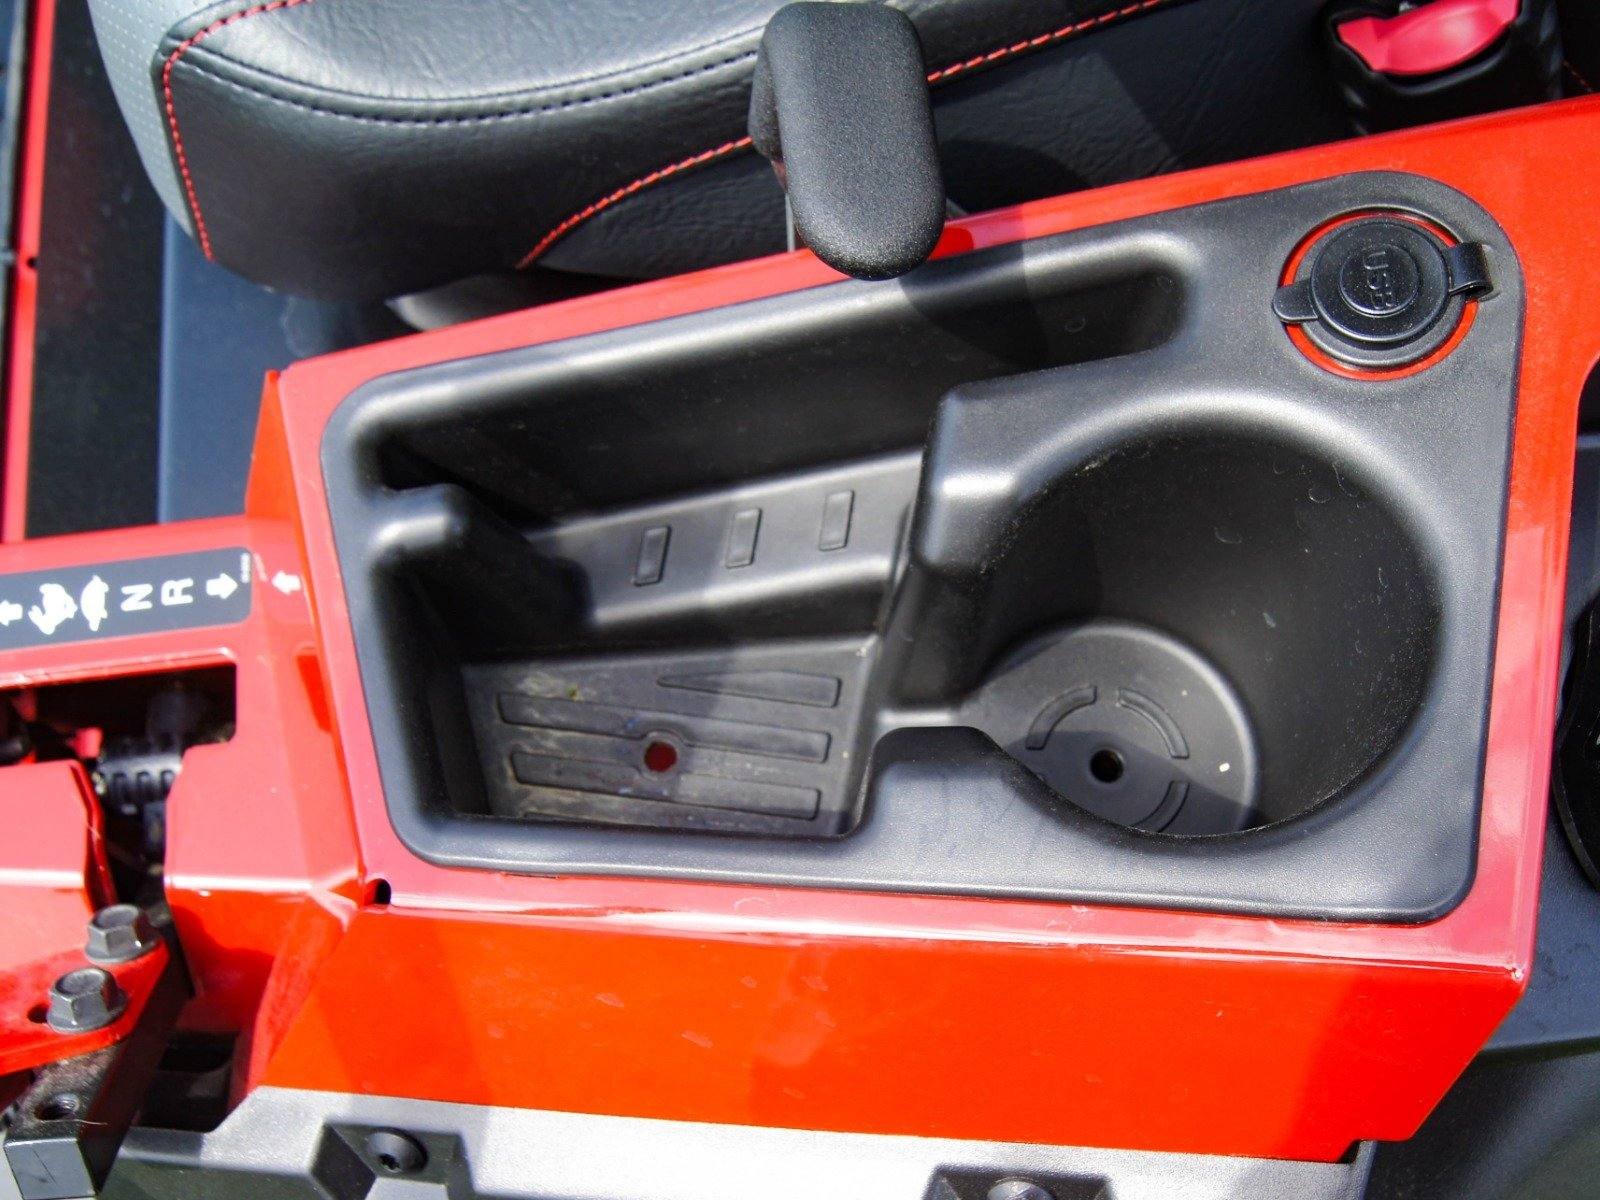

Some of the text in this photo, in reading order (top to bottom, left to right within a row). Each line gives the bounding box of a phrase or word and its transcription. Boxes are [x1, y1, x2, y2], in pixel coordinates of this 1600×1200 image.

[1362, 250, 1393, 310] USB
[120, 583, 153, 612] N
[161, 577, 194, 606] R
